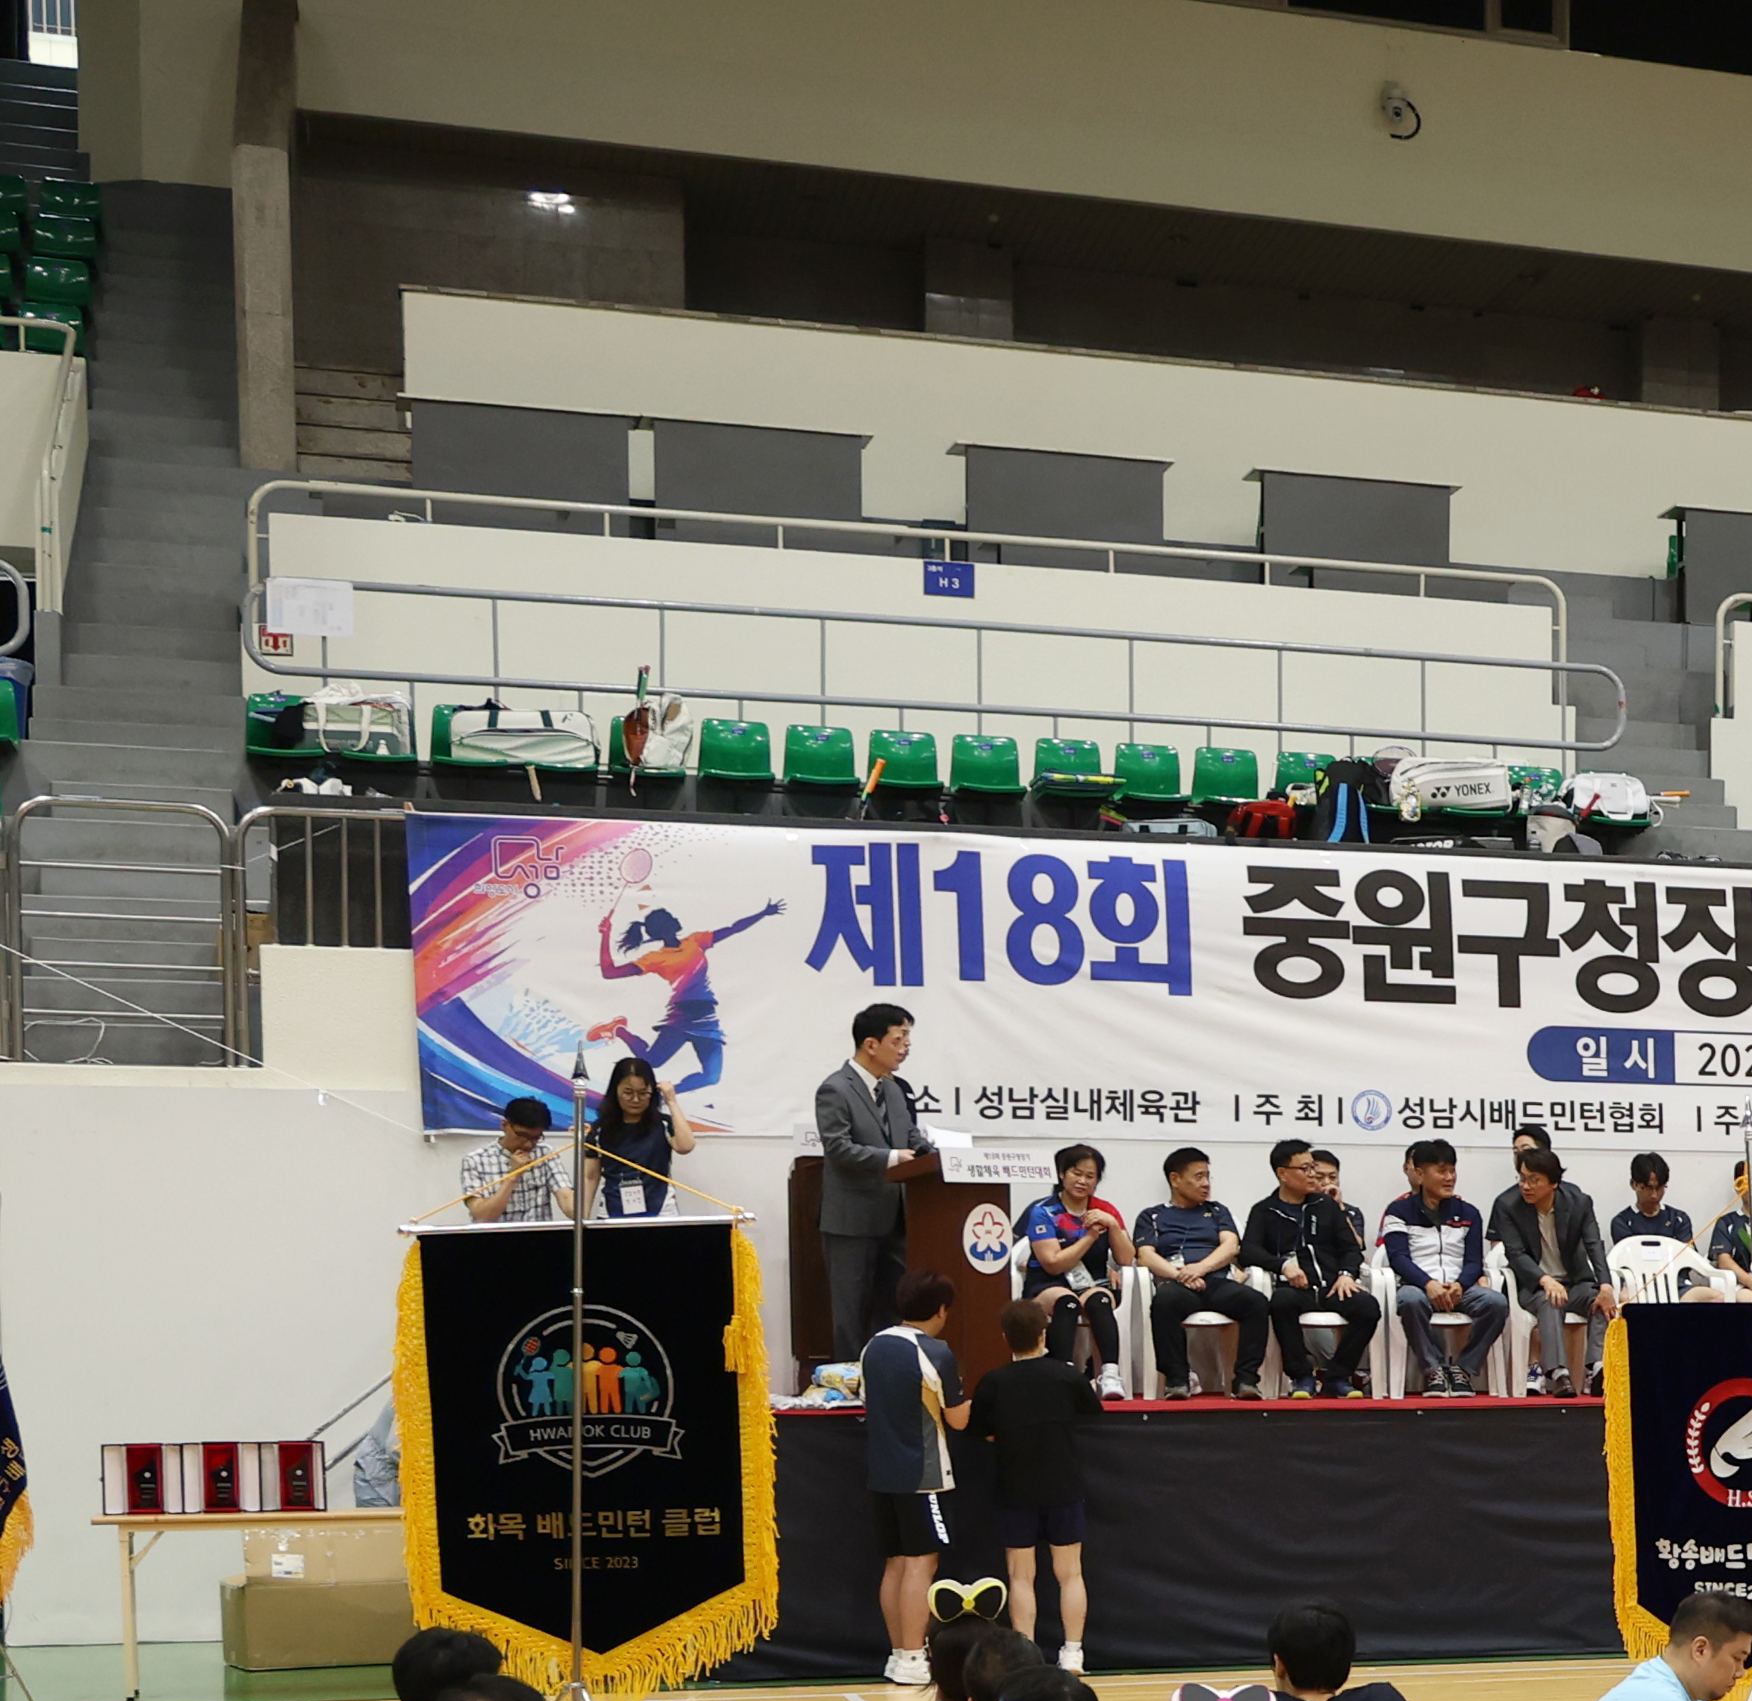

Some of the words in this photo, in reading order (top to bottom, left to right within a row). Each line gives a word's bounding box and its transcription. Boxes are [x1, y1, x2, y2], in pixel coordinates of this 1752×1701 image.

[1453, 782, 1492, 797] YONEX
[804, 842, 1192, 996] 제18회
[974, 1085, 1201, 1123] 성남실내체육관
[1397, 1096, 1664, 1135] 성남시배드민턴협회
[529, 1424, 605, 1442] HWAOK
[610, 1424, 652, 1439] CLUB
[467, 1511, 526, 1540] 화목
[536, 1508, 652, 1539] 배드민턴
[661, 1506, 721, 1538] 클럽
[553, 1556, 601, 1571] SICE
[606, 1555, 639, 1569] 2023
